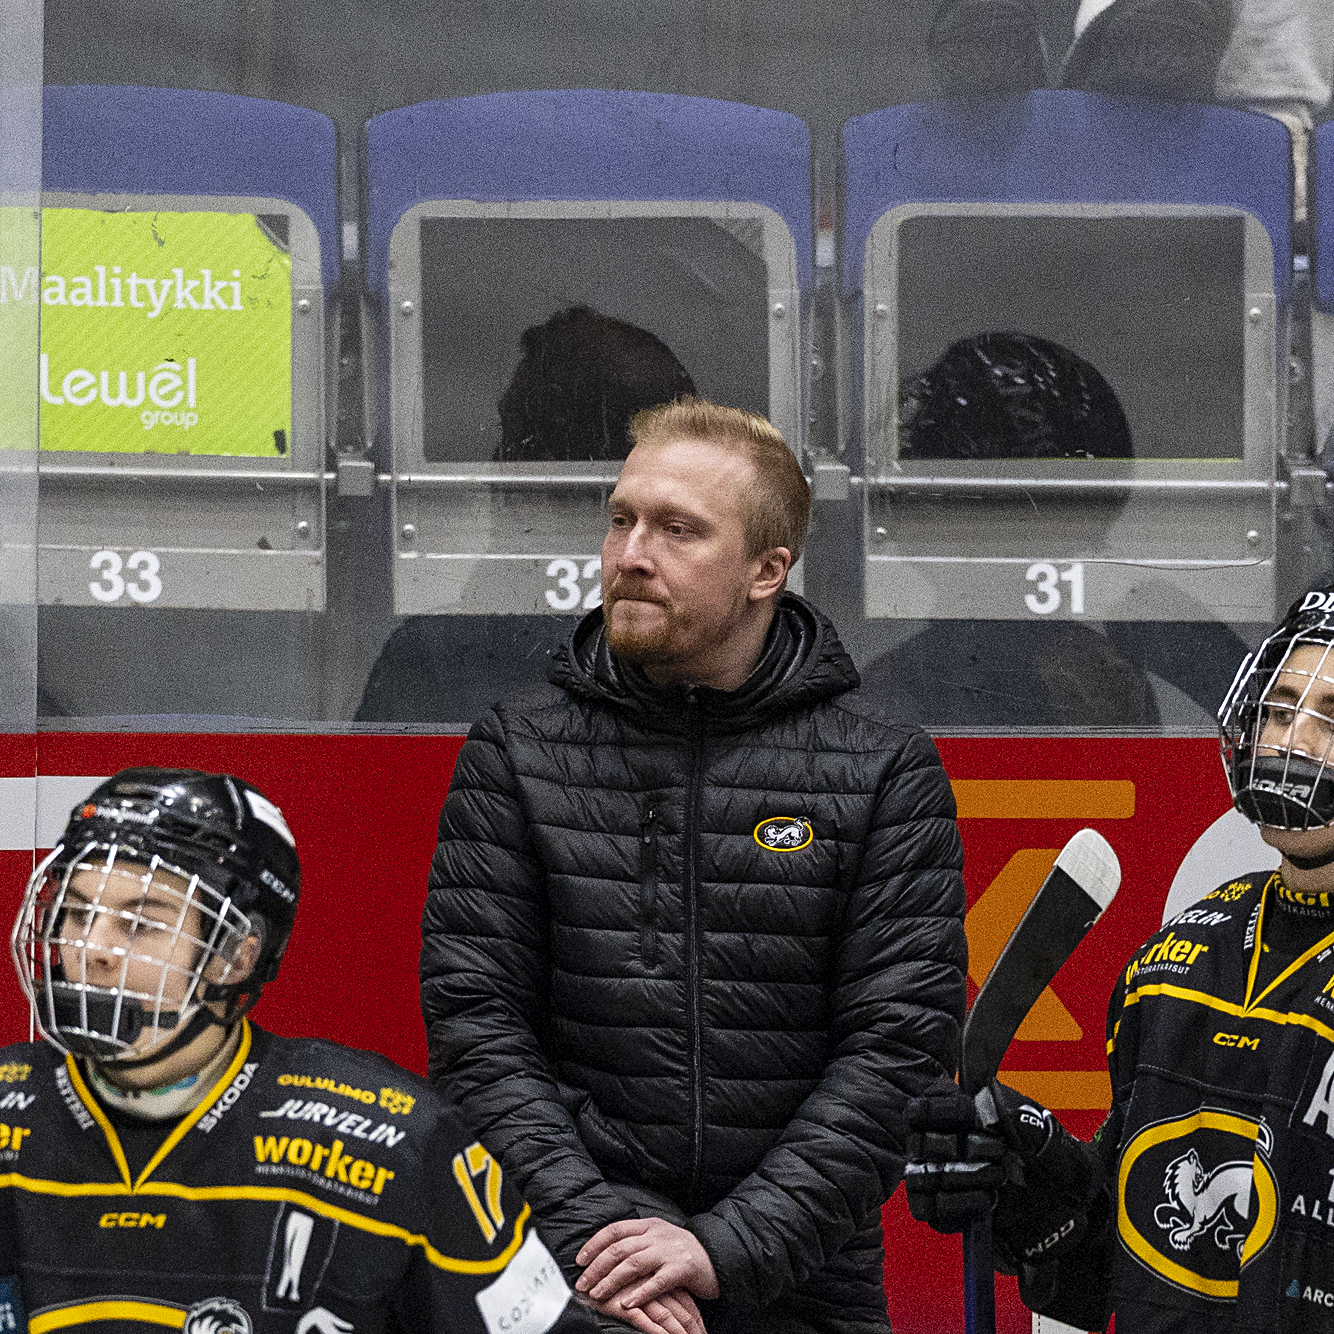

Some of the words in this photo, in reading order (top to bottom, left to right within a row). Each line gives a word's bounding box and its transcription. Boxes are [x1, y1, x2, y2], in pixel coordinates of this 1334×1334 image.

[141, 409, 198, 430] group
[89, 550, 163, 603] 33
[545, 558, 604, 612] 32
[1024, 561, 1086, 614] 31
[1213, 1032, 1260, 1051] CCM
[277, 1074, 376, 1104] OULULIMO
[259, 1099, 406, 1148] JURVELIN
[253, 1135, 395, 1195] worker
[452, 1141, 506, 1245] 17
[98, 1212, 166, 1230] CCM
